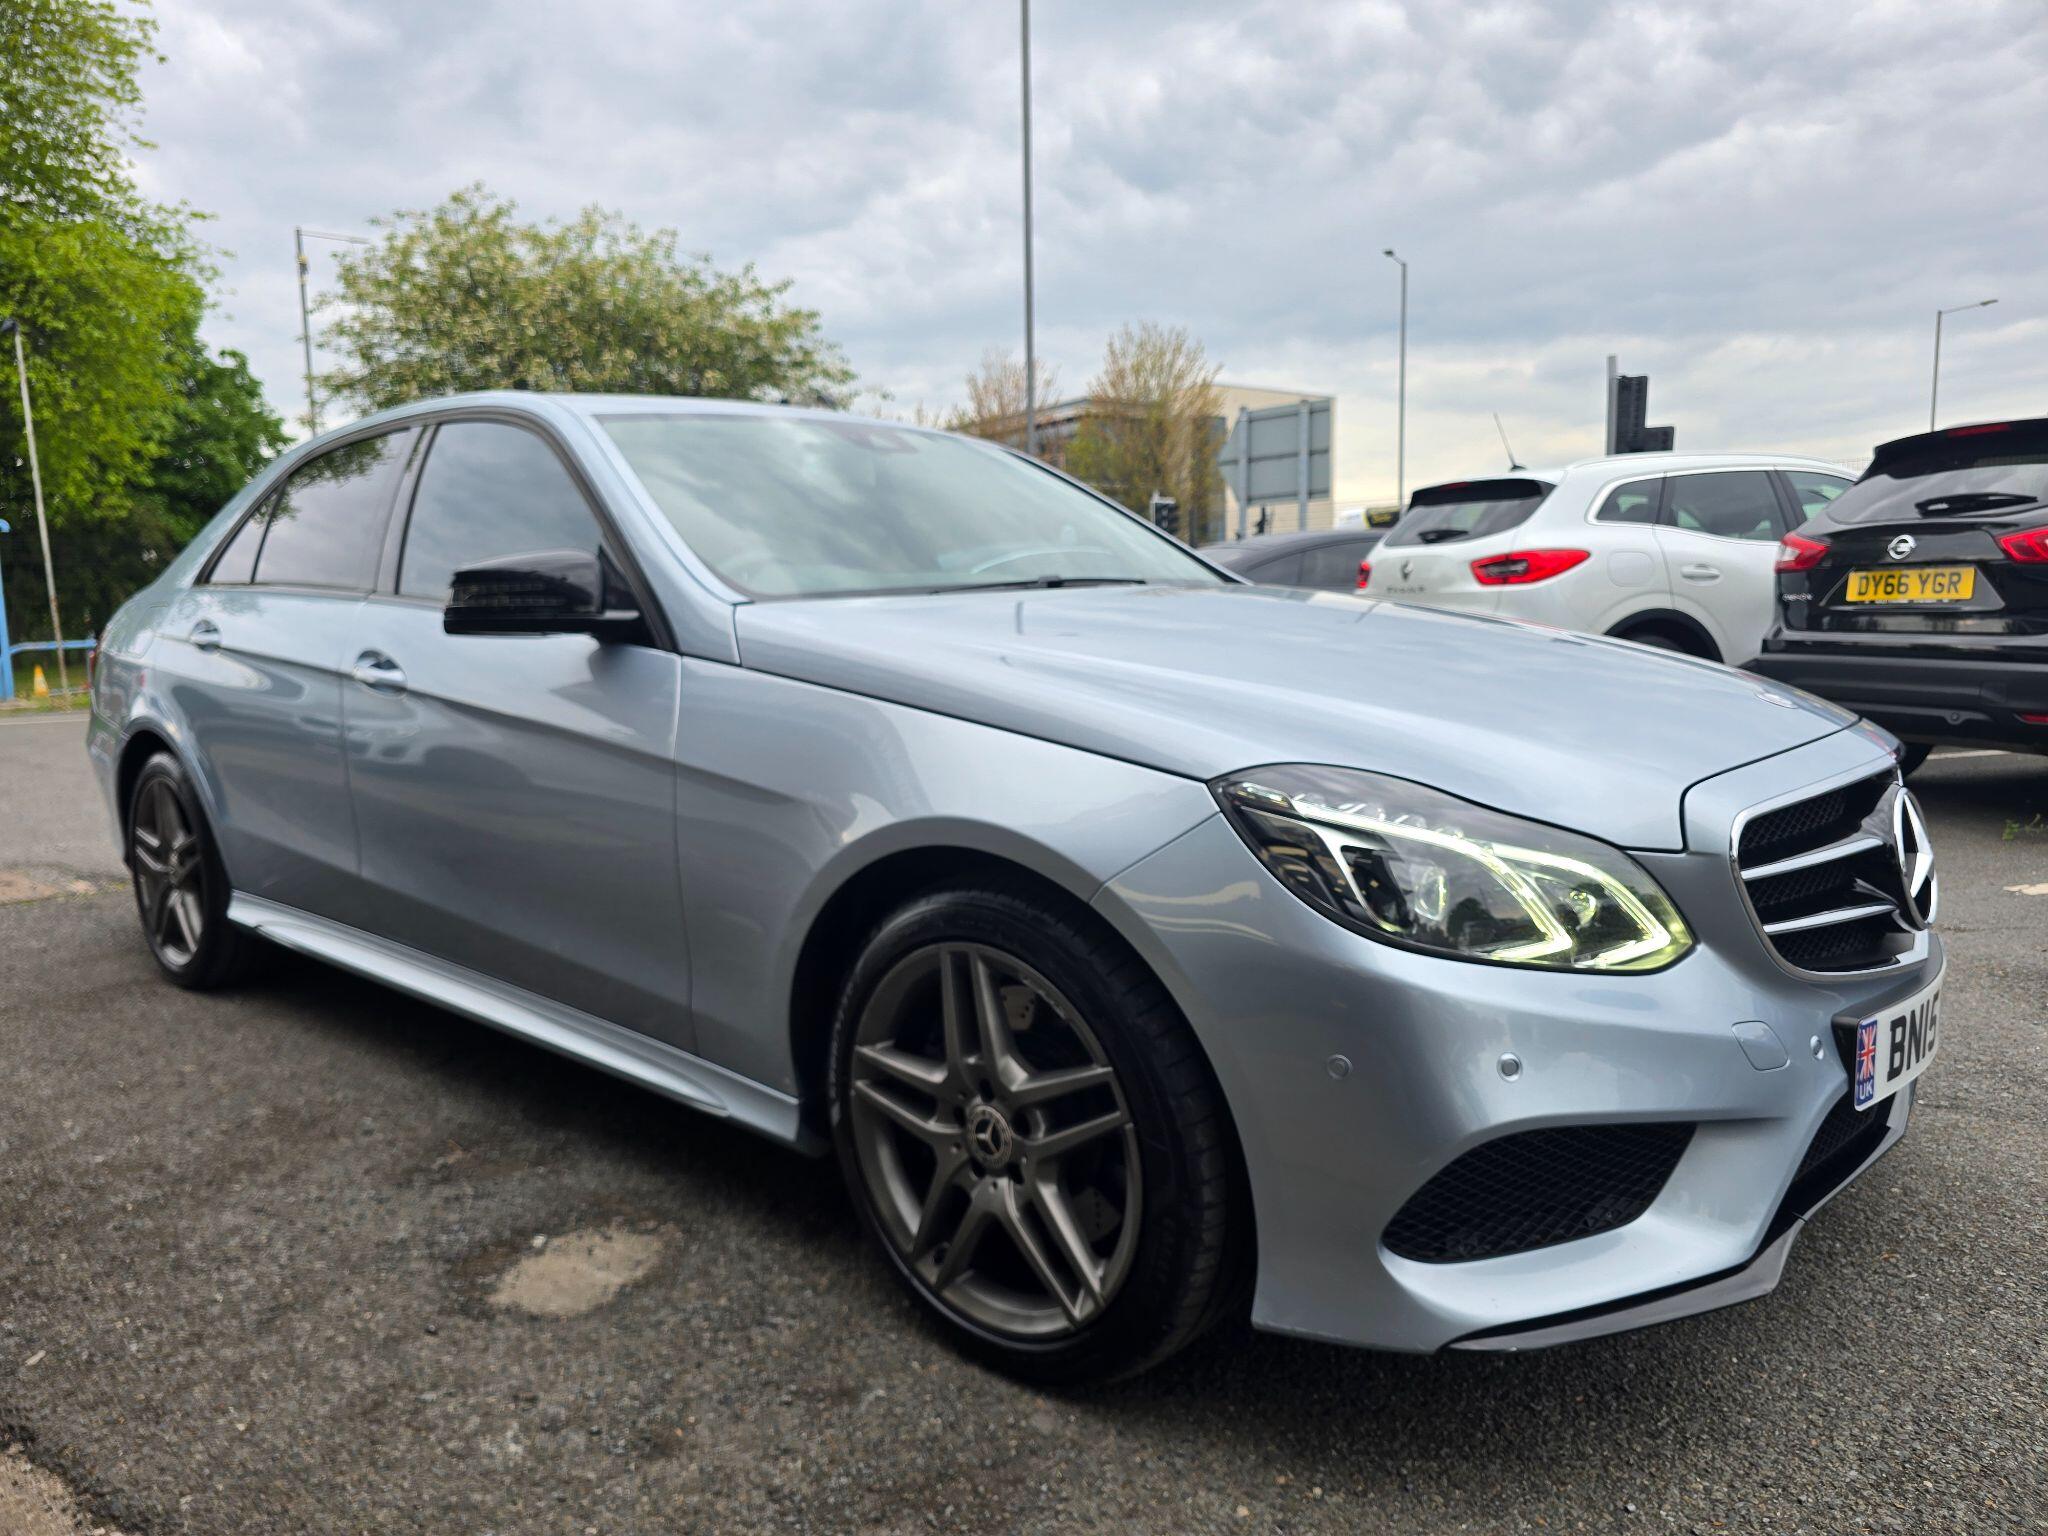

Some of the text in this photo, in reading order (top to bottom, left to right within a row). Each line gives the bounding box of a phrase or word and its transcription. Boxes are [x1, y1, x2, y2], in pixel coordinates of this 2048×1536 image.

[1857, 571, 1962, 596] DY66 YGR
[1887, 989, 1940, 1083] BN15
[1859, 1079, 1873, 1099] UK
